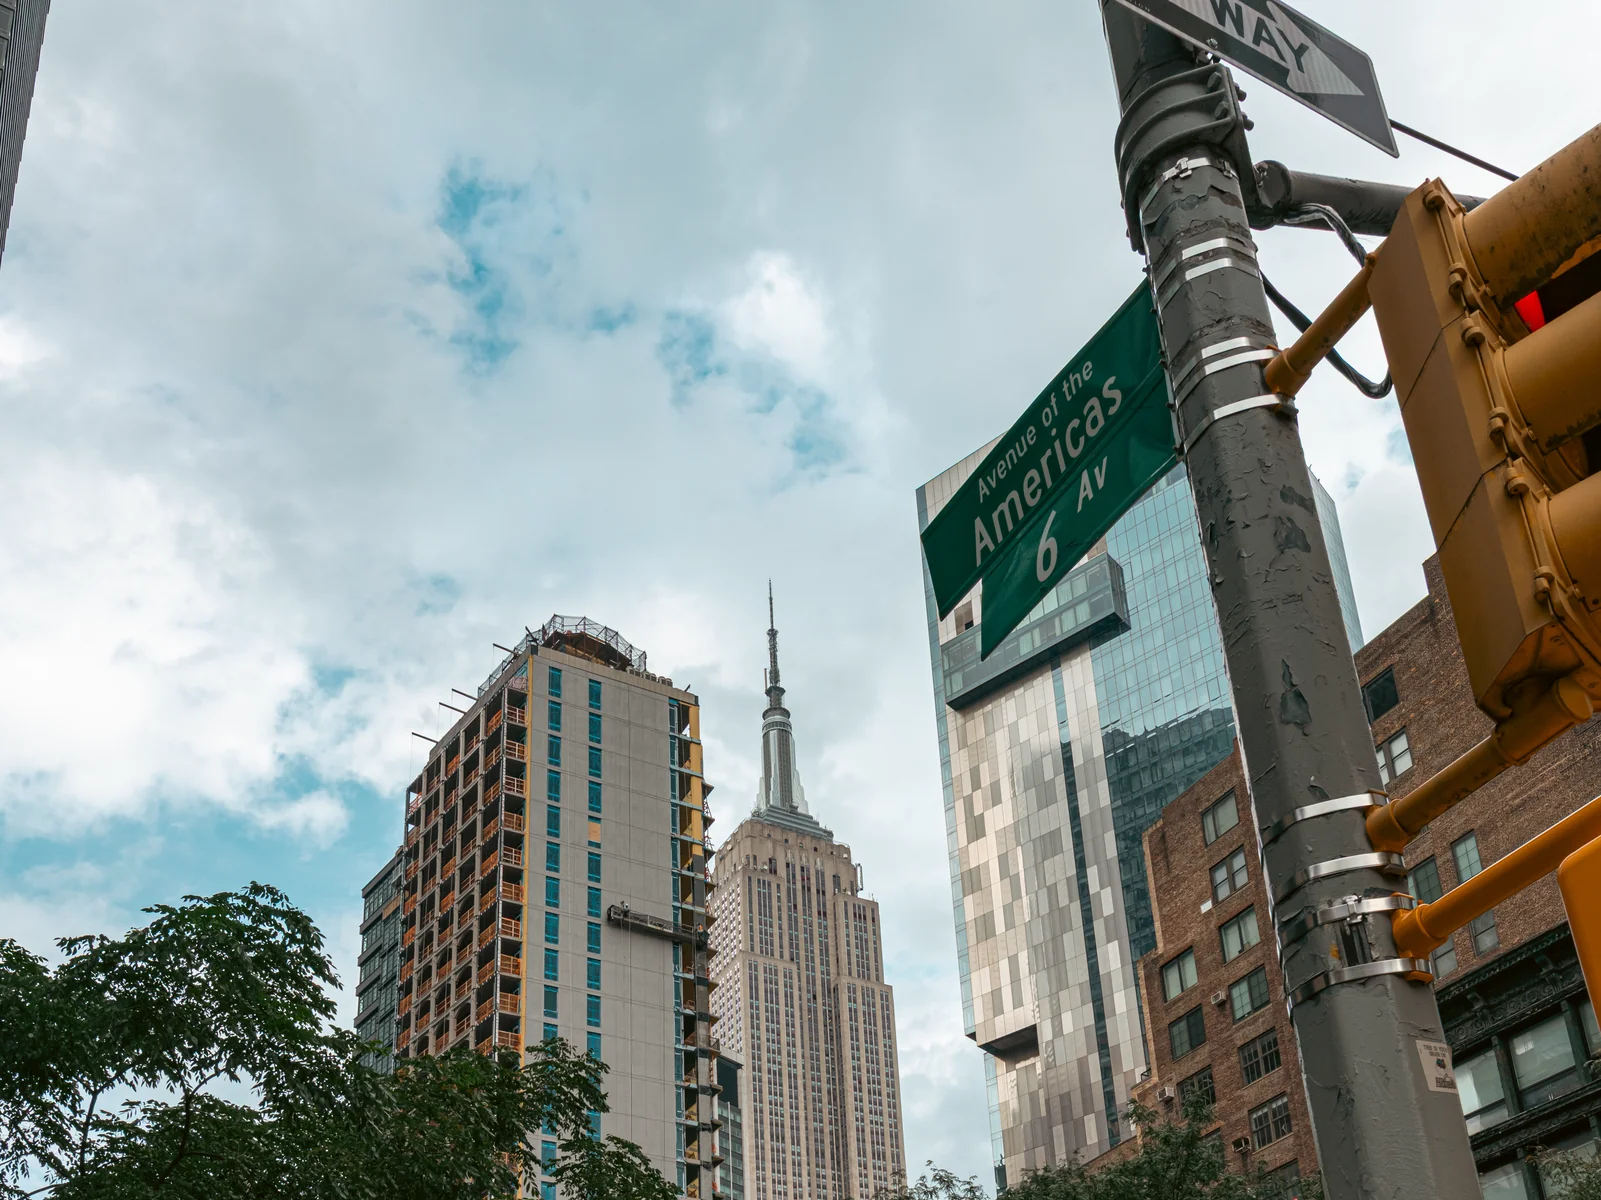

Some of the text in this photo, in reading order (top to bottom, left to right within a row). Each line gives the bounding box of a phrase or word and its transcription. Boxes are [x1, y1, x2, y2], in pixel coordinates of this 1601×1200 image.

[1211, 0, 1309, 74] WAY
[972, 375, 1122, 567] Americas
[977, 360, 1093, 504] Avenue of the
[1036, 456, 1108, 582] 6 Av
